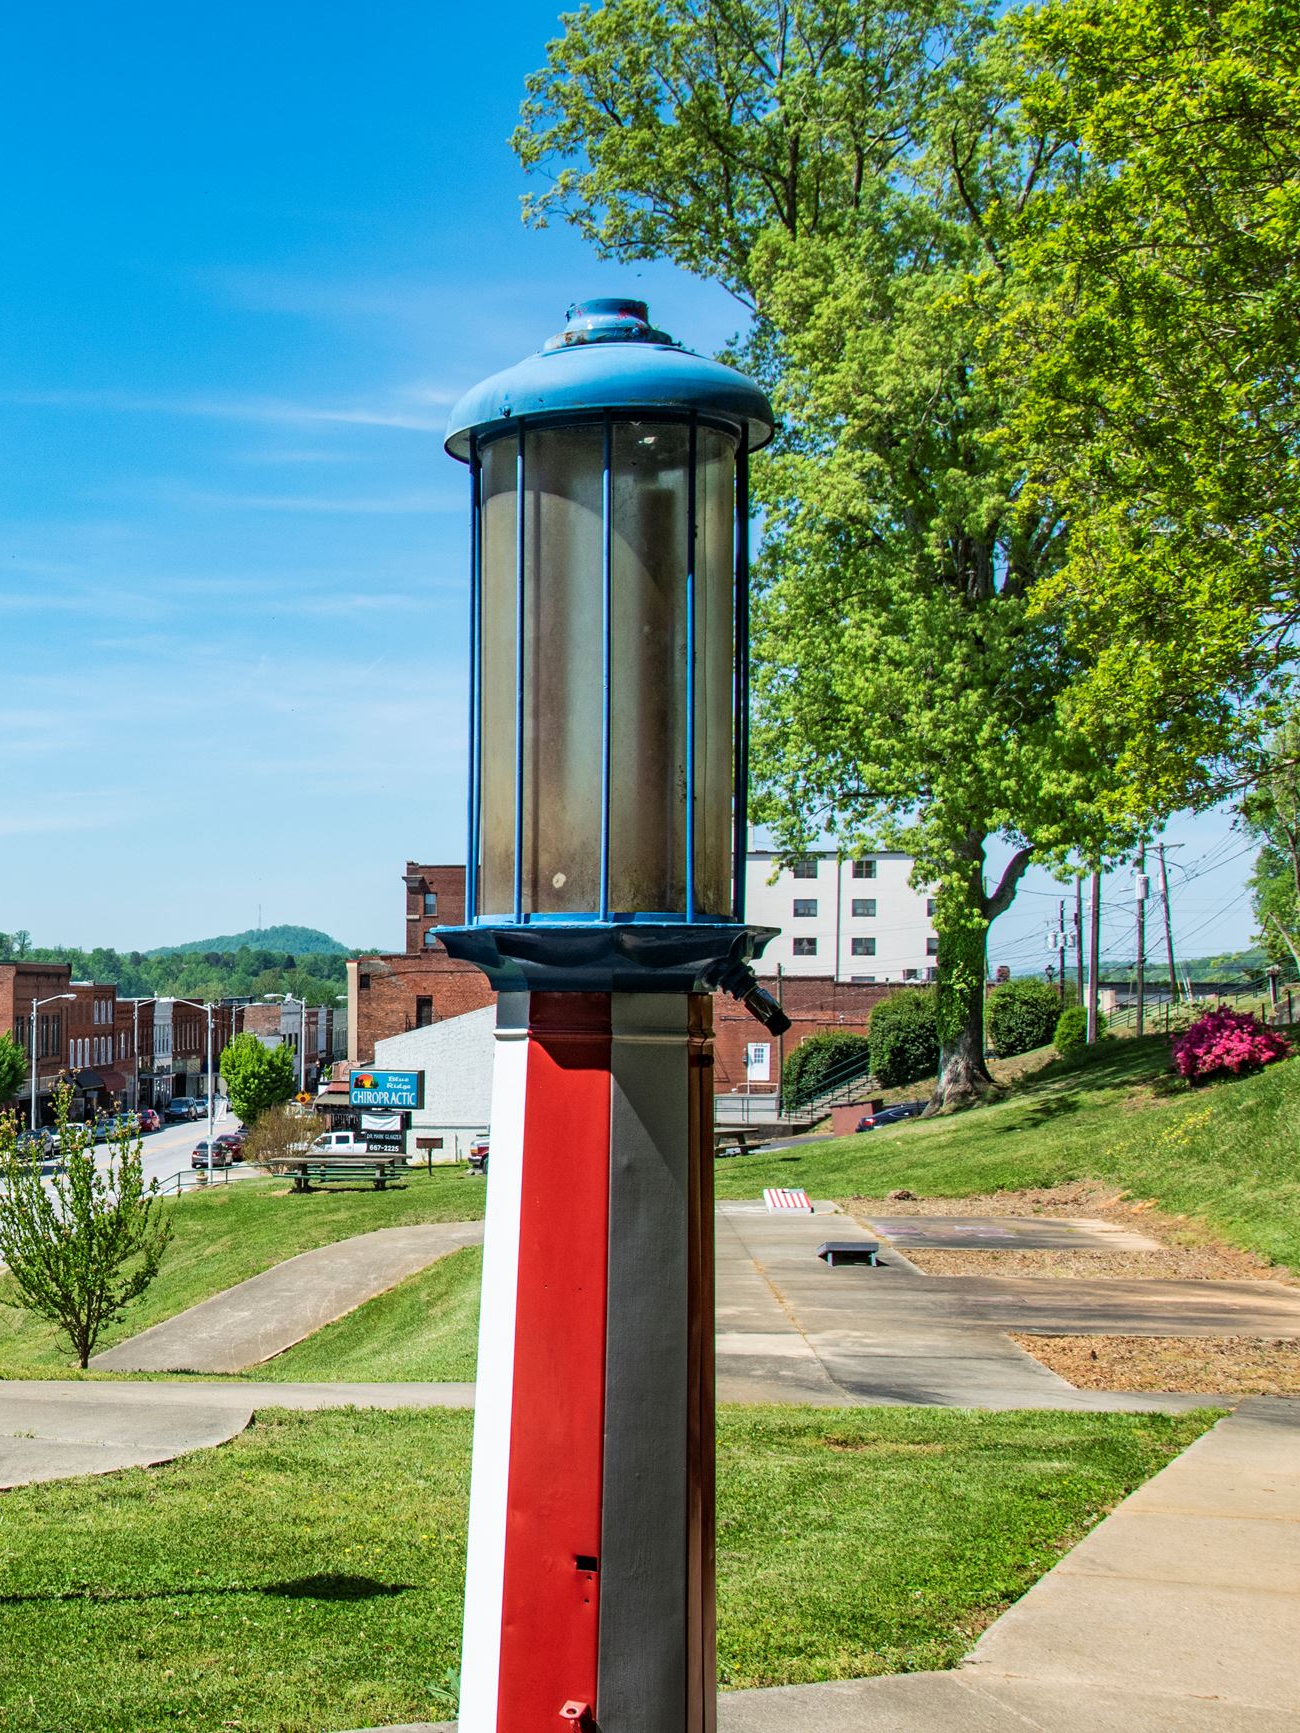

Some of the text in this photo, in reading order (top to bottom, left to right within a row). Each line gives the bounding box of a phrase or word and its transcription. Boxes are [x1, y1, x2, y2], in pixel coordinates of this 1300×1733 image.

[387, 1082, 411, 1090] Ridge
[352, 1091, 416, 1105] CHIROPRACTIC
[369, 1144, 399, 1152] 667-2225
